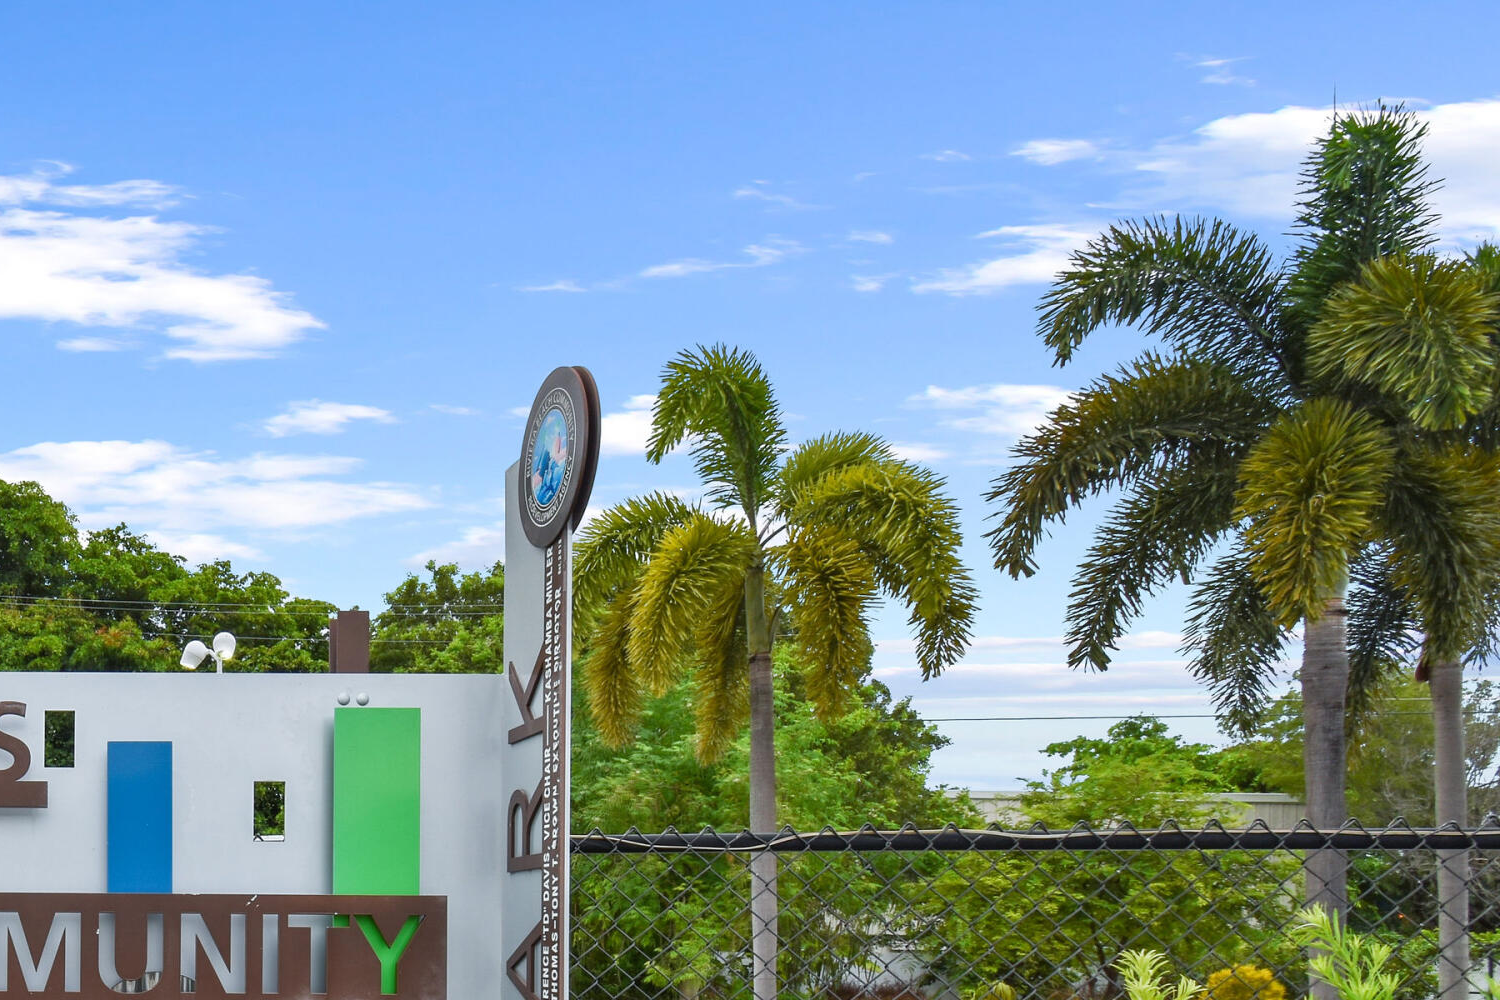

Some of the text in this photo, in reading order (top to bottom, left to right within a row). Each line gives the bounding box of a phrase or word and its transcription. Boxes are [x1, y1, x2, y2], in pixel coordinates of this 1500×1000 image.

[553, 391, 575, 441] COMMUNITY
[559, 455, 573, 502] AGENCY
[543, 846, 551, 902] DAVIS,
[552, 854, 559, 868] T.
